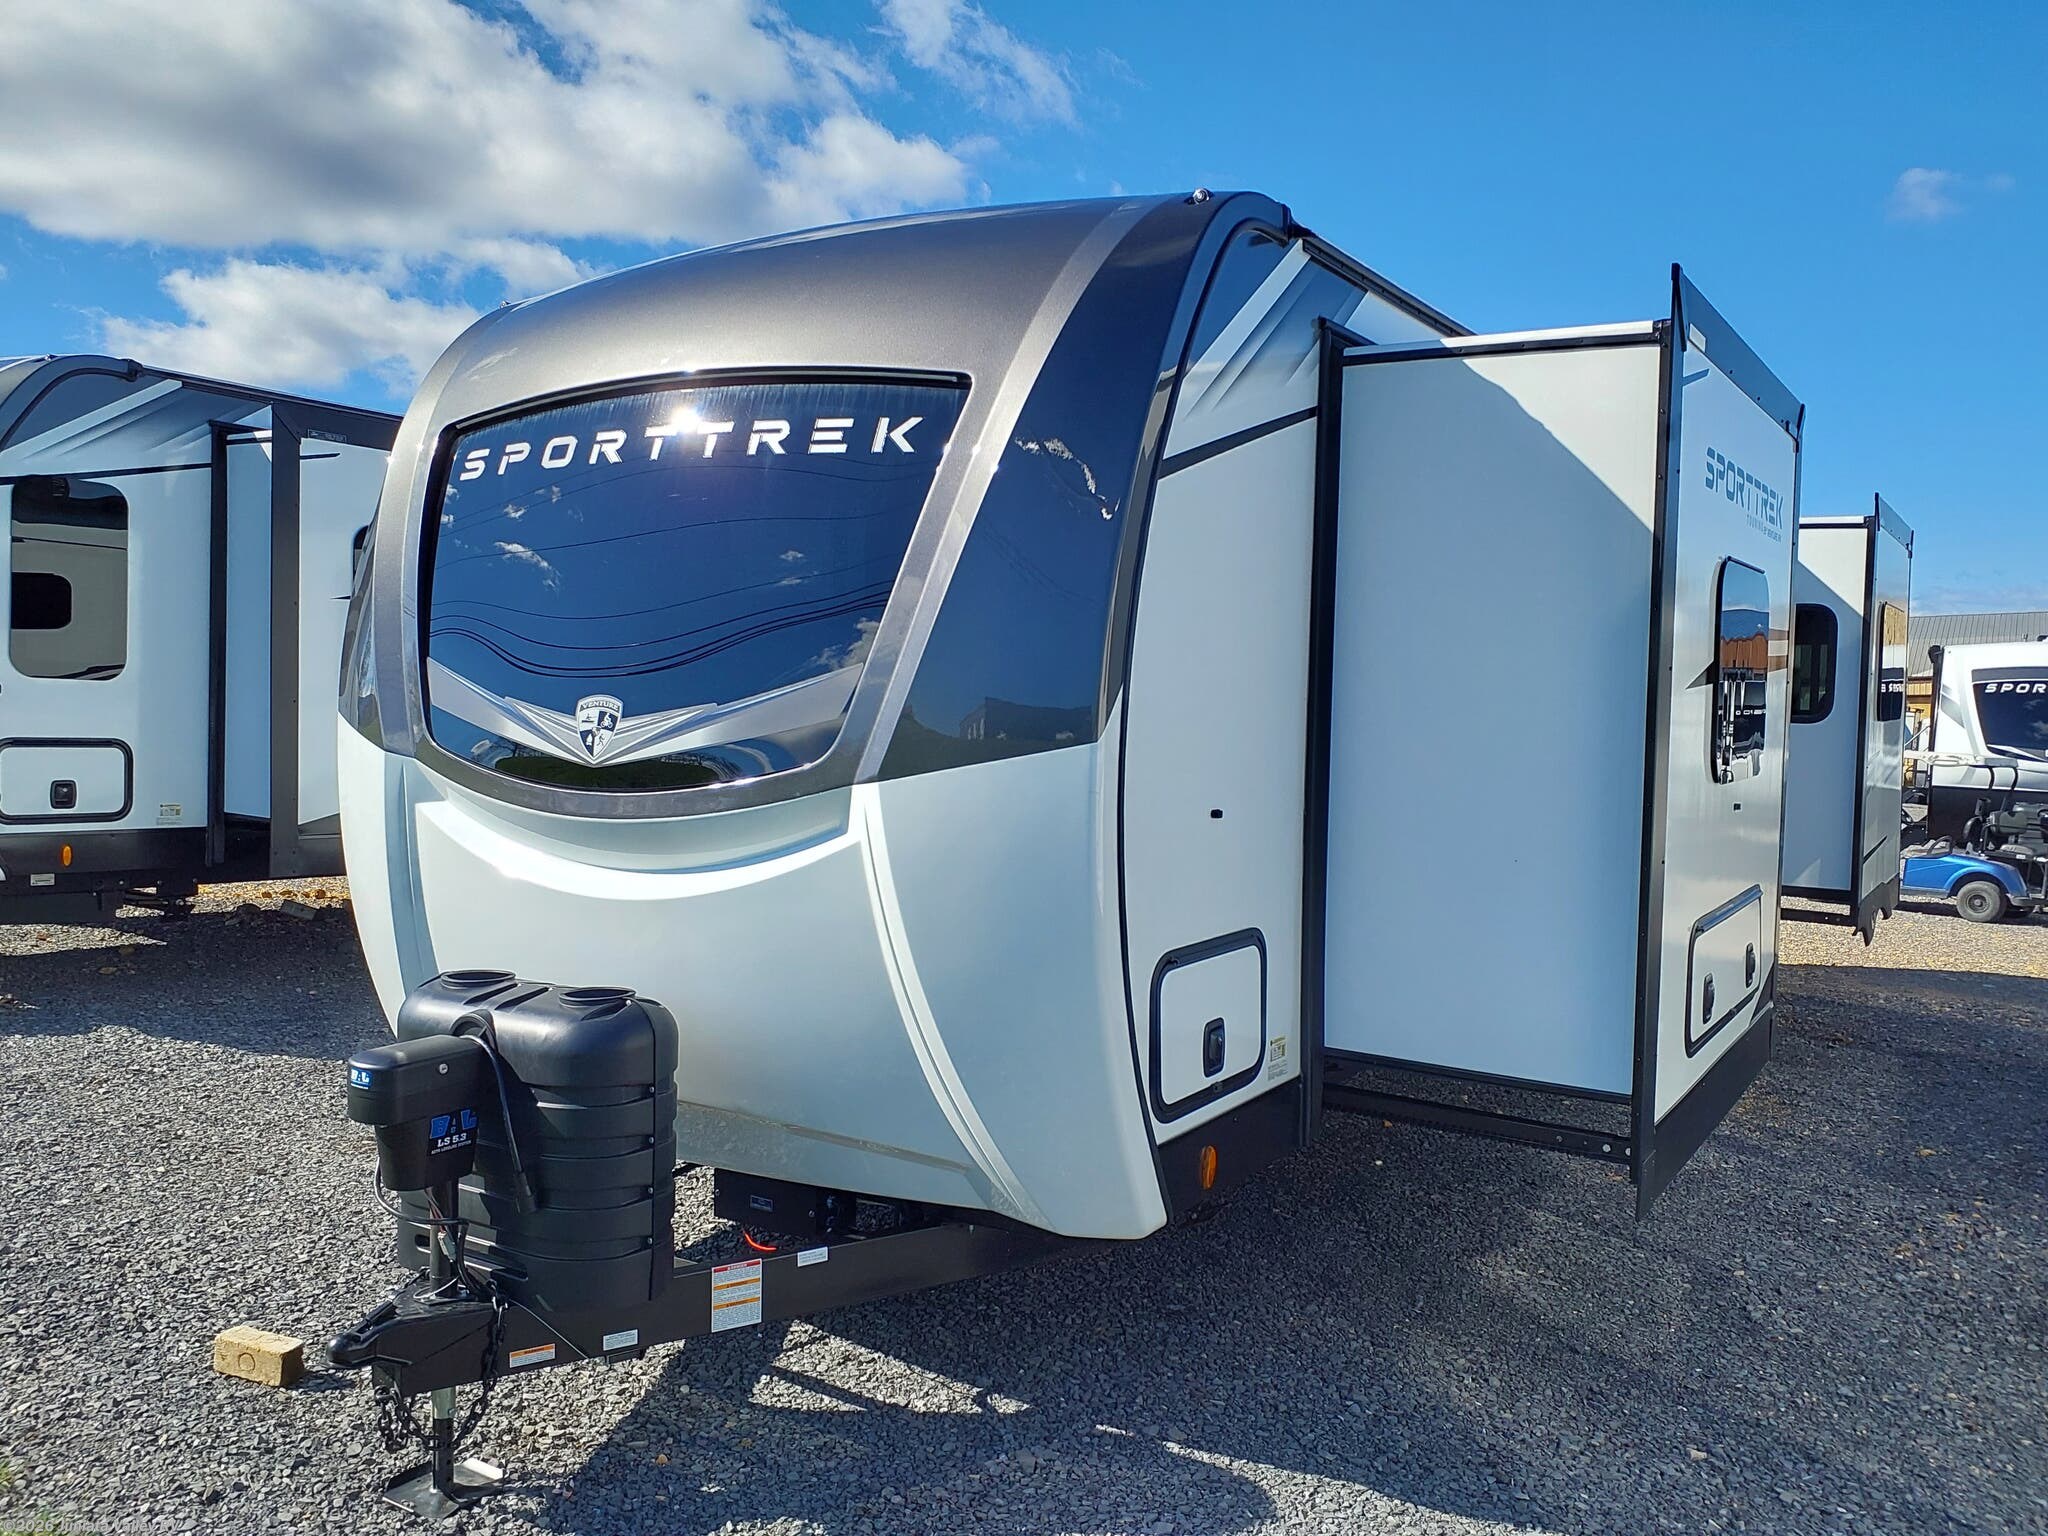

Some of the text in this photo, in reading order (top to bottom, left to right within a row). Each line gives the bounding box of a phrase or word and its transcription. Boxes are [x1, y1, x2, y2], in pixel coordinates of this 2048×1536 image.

[459, 416, 925, 481] SPORTTREK
[1705, 446, 1784, 530] SPORTTREK
[1984, 683, 2047, 694] SPOR
[581, 700, 619, 711] VENTURE
[437, 1136, 451, 1148] LS
